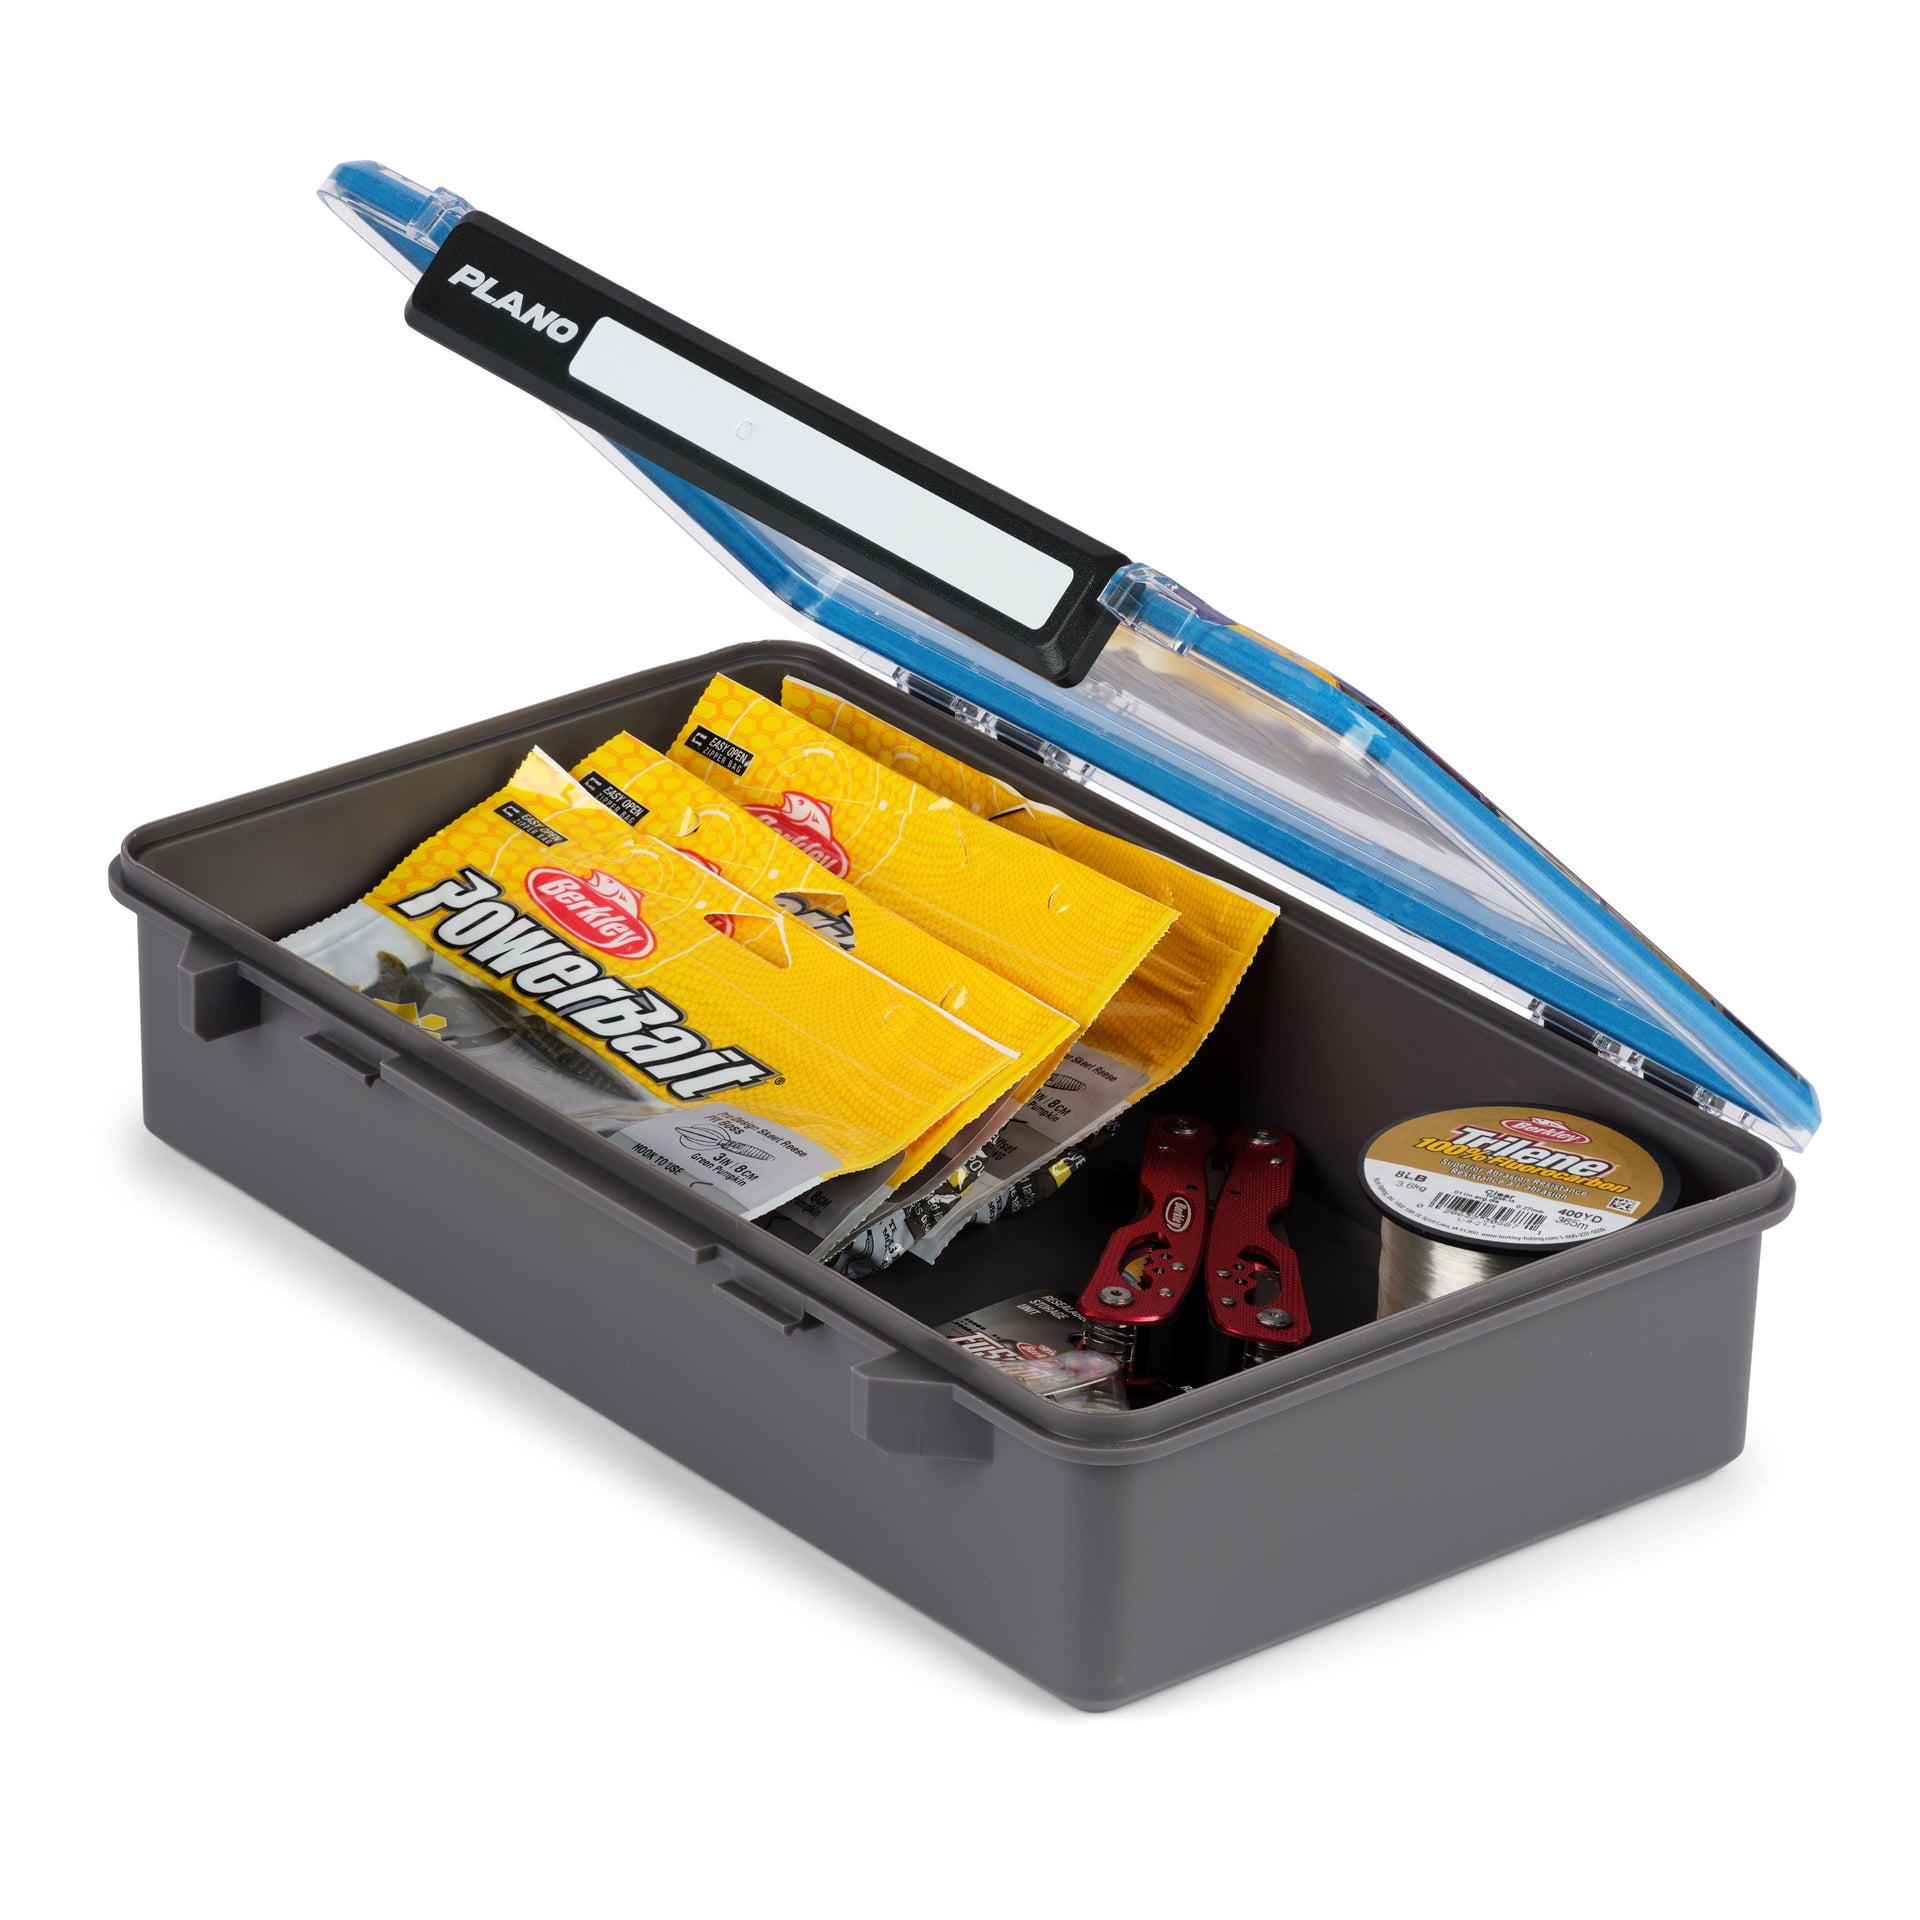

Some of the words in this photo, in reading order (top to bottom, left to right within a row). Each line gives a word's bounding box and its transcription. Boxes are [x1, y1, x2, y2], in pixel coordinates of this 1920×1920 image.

[447, 264, 579, 343] PLANO
[703, 747, 726, 764] ZIPPER
[727, 760, 742, 773] BAG
[708, 737, 729, 754] EASY
[727, 746, 748, 764] OPEN
[603, 786, 624, 804] EASY
[622, 799, 644, 817] OPEN
[521, 814, 543, 830] EASY
[540, 826, 563, 842] OPEN
[621, 812, 636, 825] BAG
[513, 819, 538, 835] ZIPPER
[537, 834, 553, 845] BAG
[537, 876, 643, 942] Berkley
[1071, 1056, 1095, 1071] Skeet
[1027, 1100, 1059, 1123] Pumpkin
[1048, 1100, 1071, 1115] 8CM
[757, 1127, 783, 1146] Skeet
[779, 1137, 807, 1158] Reese
[1514, 1121, 1580, 1143] Berkley
[632, 1143, 658, 1162] HOOK
[654, 1154, 669, 1169] TO
[666, 1162, 684, 1176] USE
[1449, 1125, 1615, 1178] Trilene
[691, 1153, 714, 1170] Green
[714, 1164, 746, 1187] Pumpkin
[1414, 1137, 1486, 1162] 100%
[1486, 1155, 1630, 1194] Fluorocarbon
[1440, 1158, 1485, 1174] Superior
[1486, 1168, 1530, 1184] Abrasion
[1532, 1178, 1588, 1197] Resistance
[1450, 1168, 1504, 1185] Resistance
[1485, 1189, 1516, 1200] Clear
[793, 1199, 820, 1217] umpkin
[1558, 1208, 1603, 1223] 400YD
[1555, 1216, 1589, 1230] 365m
[1017, 1303, 1042, 1316] UNIT
[1029, 1299, 1069, 1320] STORAGE
